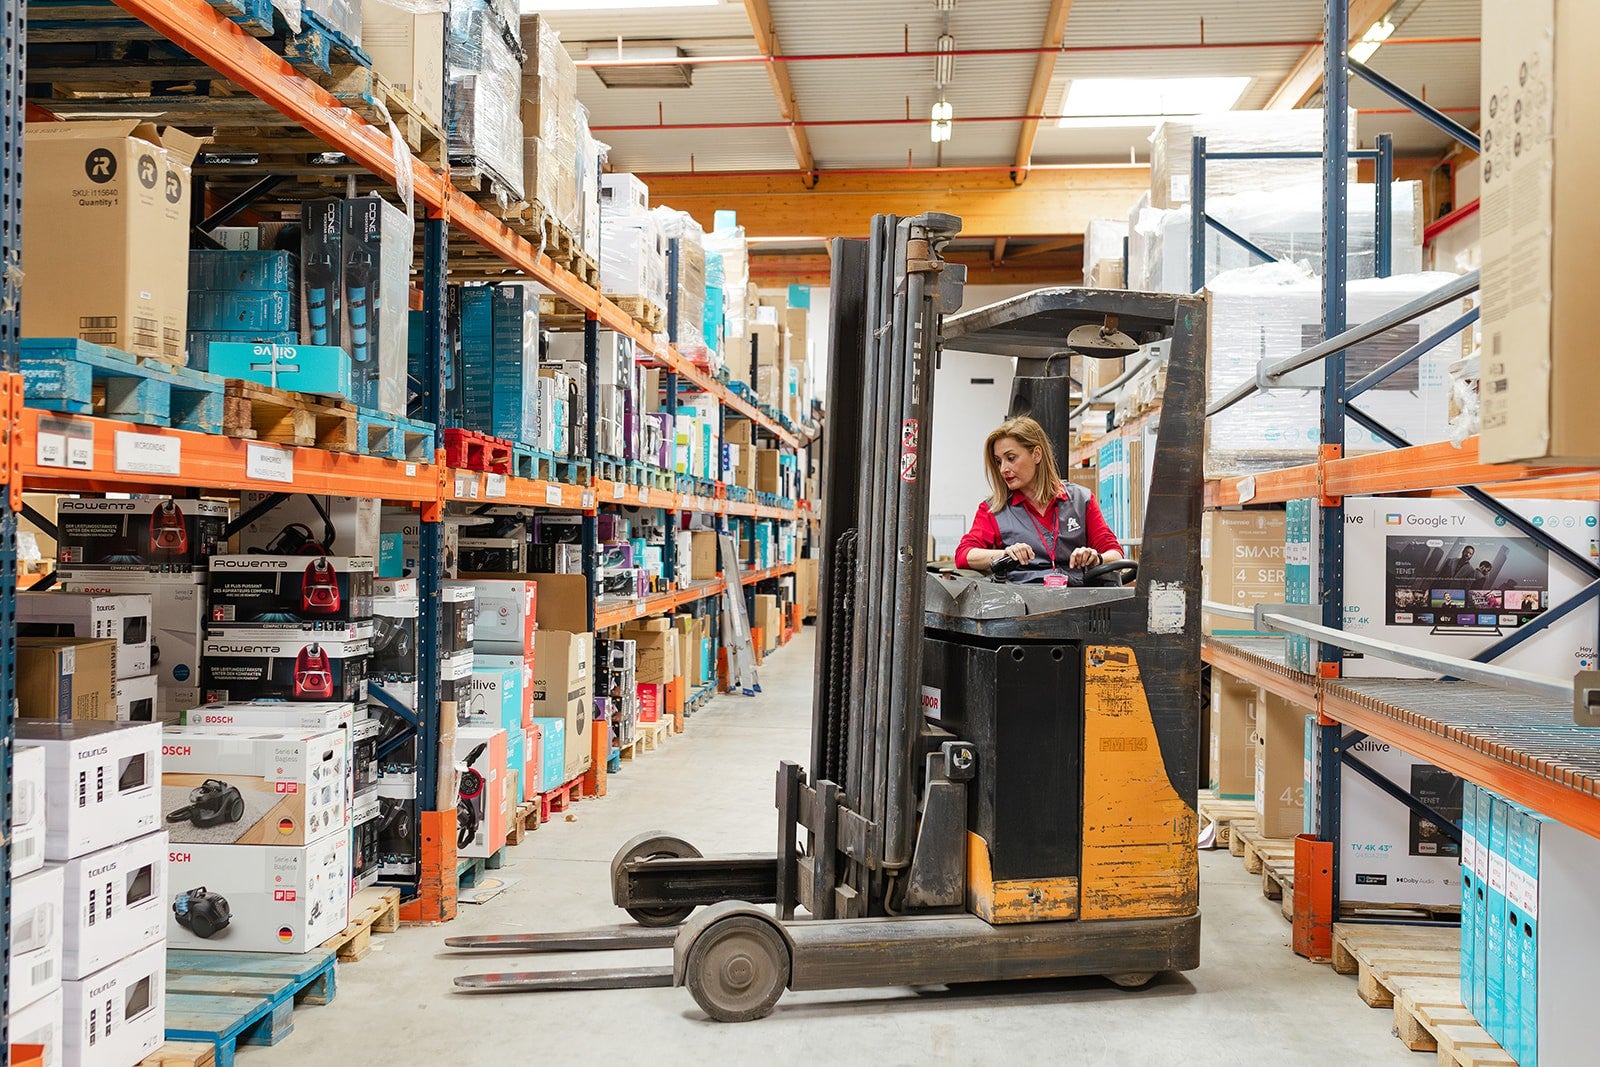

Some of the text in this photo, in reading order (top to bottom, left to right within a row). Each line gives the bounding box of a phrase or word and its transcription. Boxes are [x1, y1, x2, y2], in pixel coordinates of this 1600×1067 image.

[79, 199, 112, 207] Quantity
[254, 345, 297, 359] Qilve
[1406, 514, 1466, 528] Google TV
[1236, 569, 1247, 581] 4
[1395, 567, 1416, 575] TENET
[96, 604, 116, 612] taurus
[205, 715, 233, 724] BOSCH
[1353, 741, 1390, 752] Qilive
[78, 746, 108, 760] taurus
[1280, 786, 1305, 807] 43
[168, 852, 191, 863] SCH
[88, 861, 117, 878] taurus
[90, 978, 117, 998] taurus
